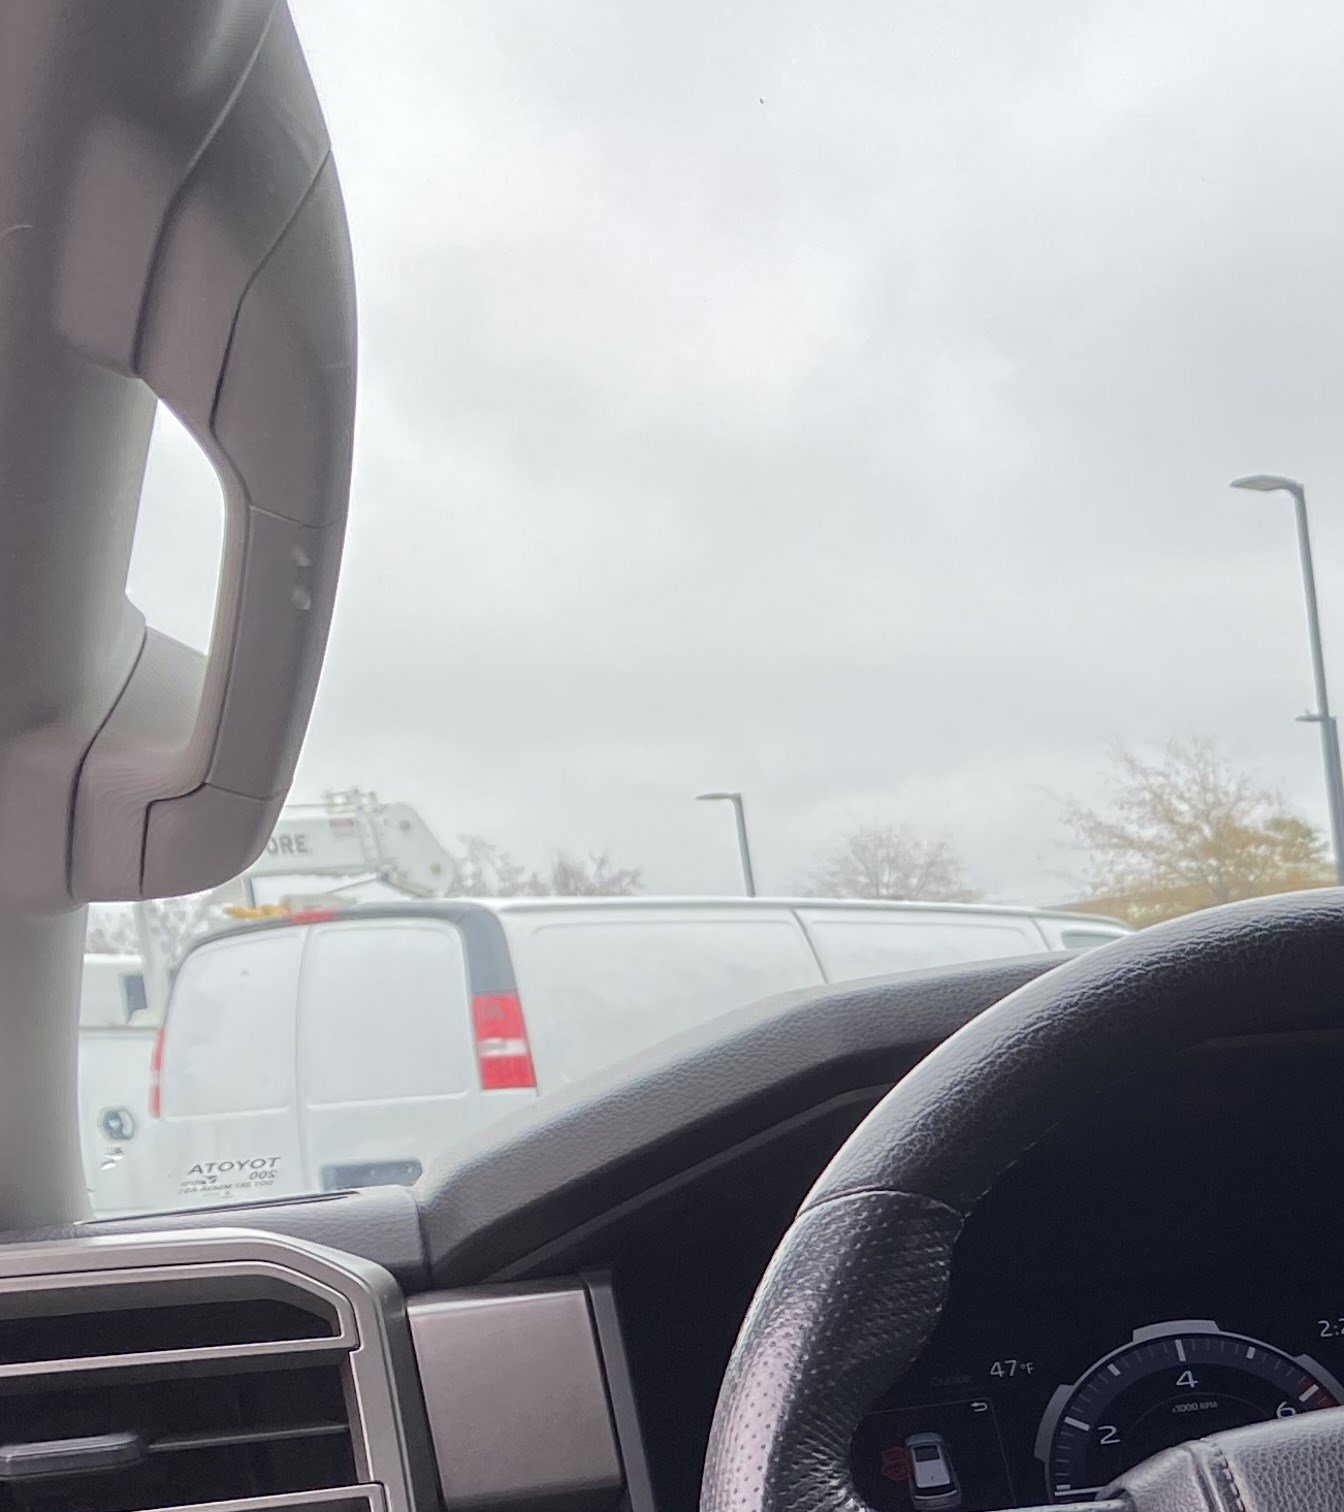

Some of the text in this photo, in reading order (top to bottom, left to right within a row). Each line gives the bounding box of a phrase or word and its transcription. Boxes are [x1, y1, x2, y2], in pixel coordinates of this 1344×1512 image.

[1175, 1370, 1199, 1389] 4
[1275, 1400, 1297, 1419] 6
[1097, 1425, 1121, 1445] 2
